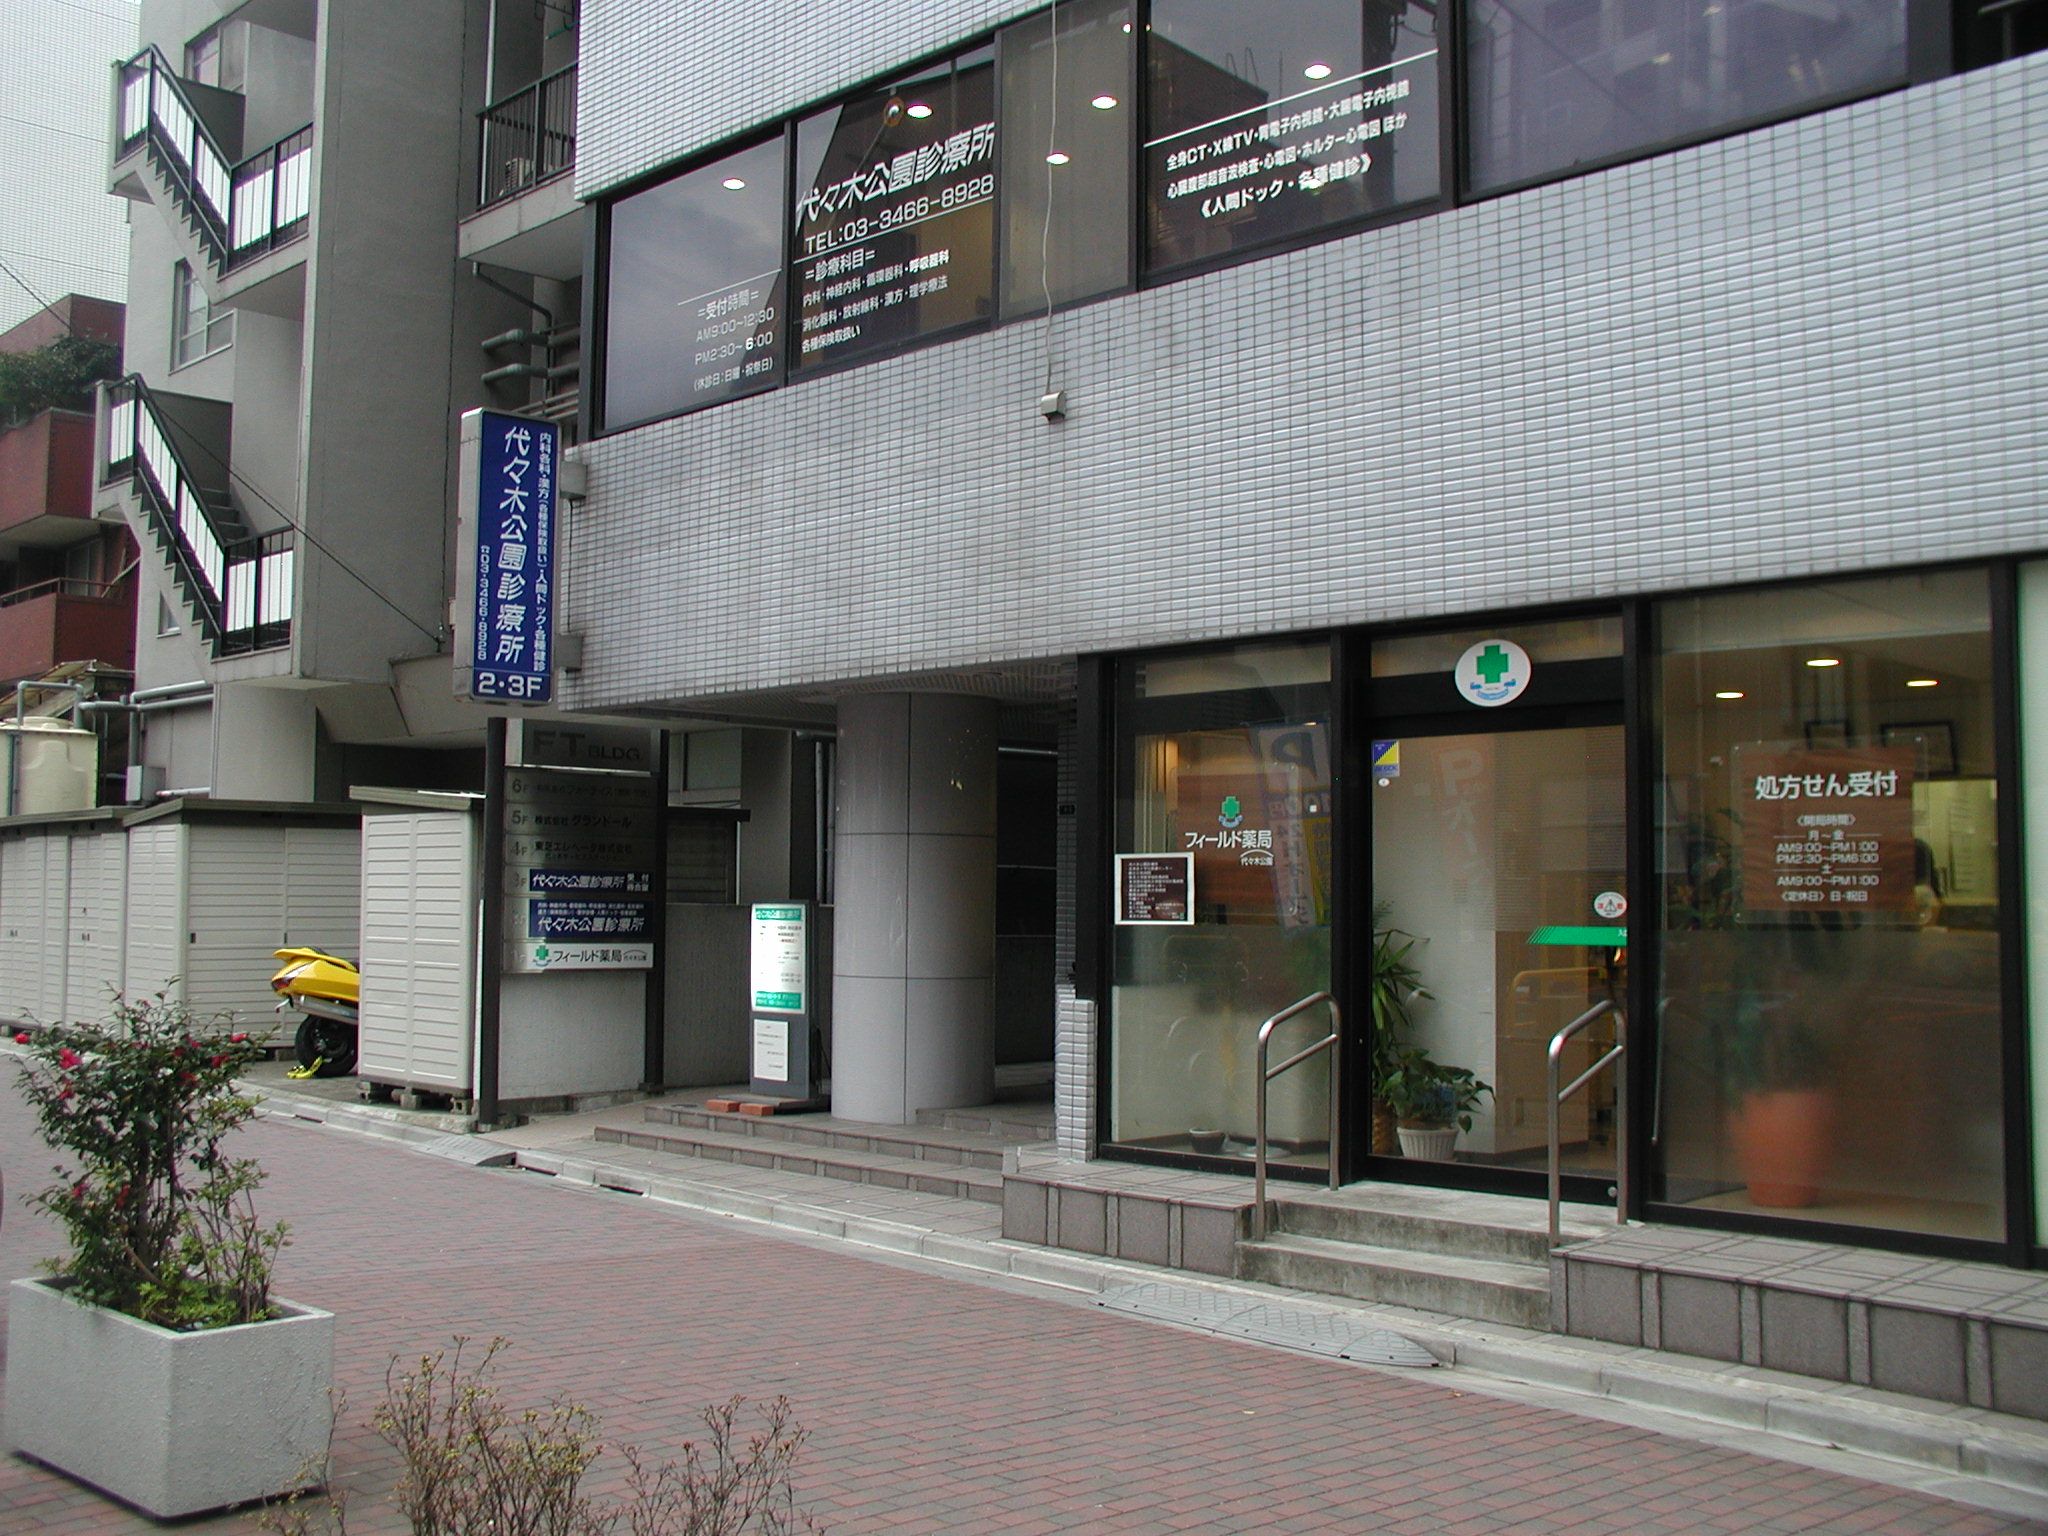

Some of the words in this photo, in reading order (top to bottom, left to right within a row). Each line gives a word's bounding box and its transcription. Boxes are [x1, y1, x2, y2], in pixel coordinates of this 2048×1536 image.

[796, 121, 996, 236] 代々木公園診療所
[805, 173, 995, 254] TEL:03-3466-8928
[494, 425, 531, 665] 代々木公園診療所
[1755, 769, 1899, 800] 処方せん受付
[1184, 829, 1273, 849] フィールド薬局
[532, 873, 625, 889] 代々木公園診療所
[538, 916, 645, 932] 代々木公園診療所
[553, 949, 622, 962] フィールド薬局
